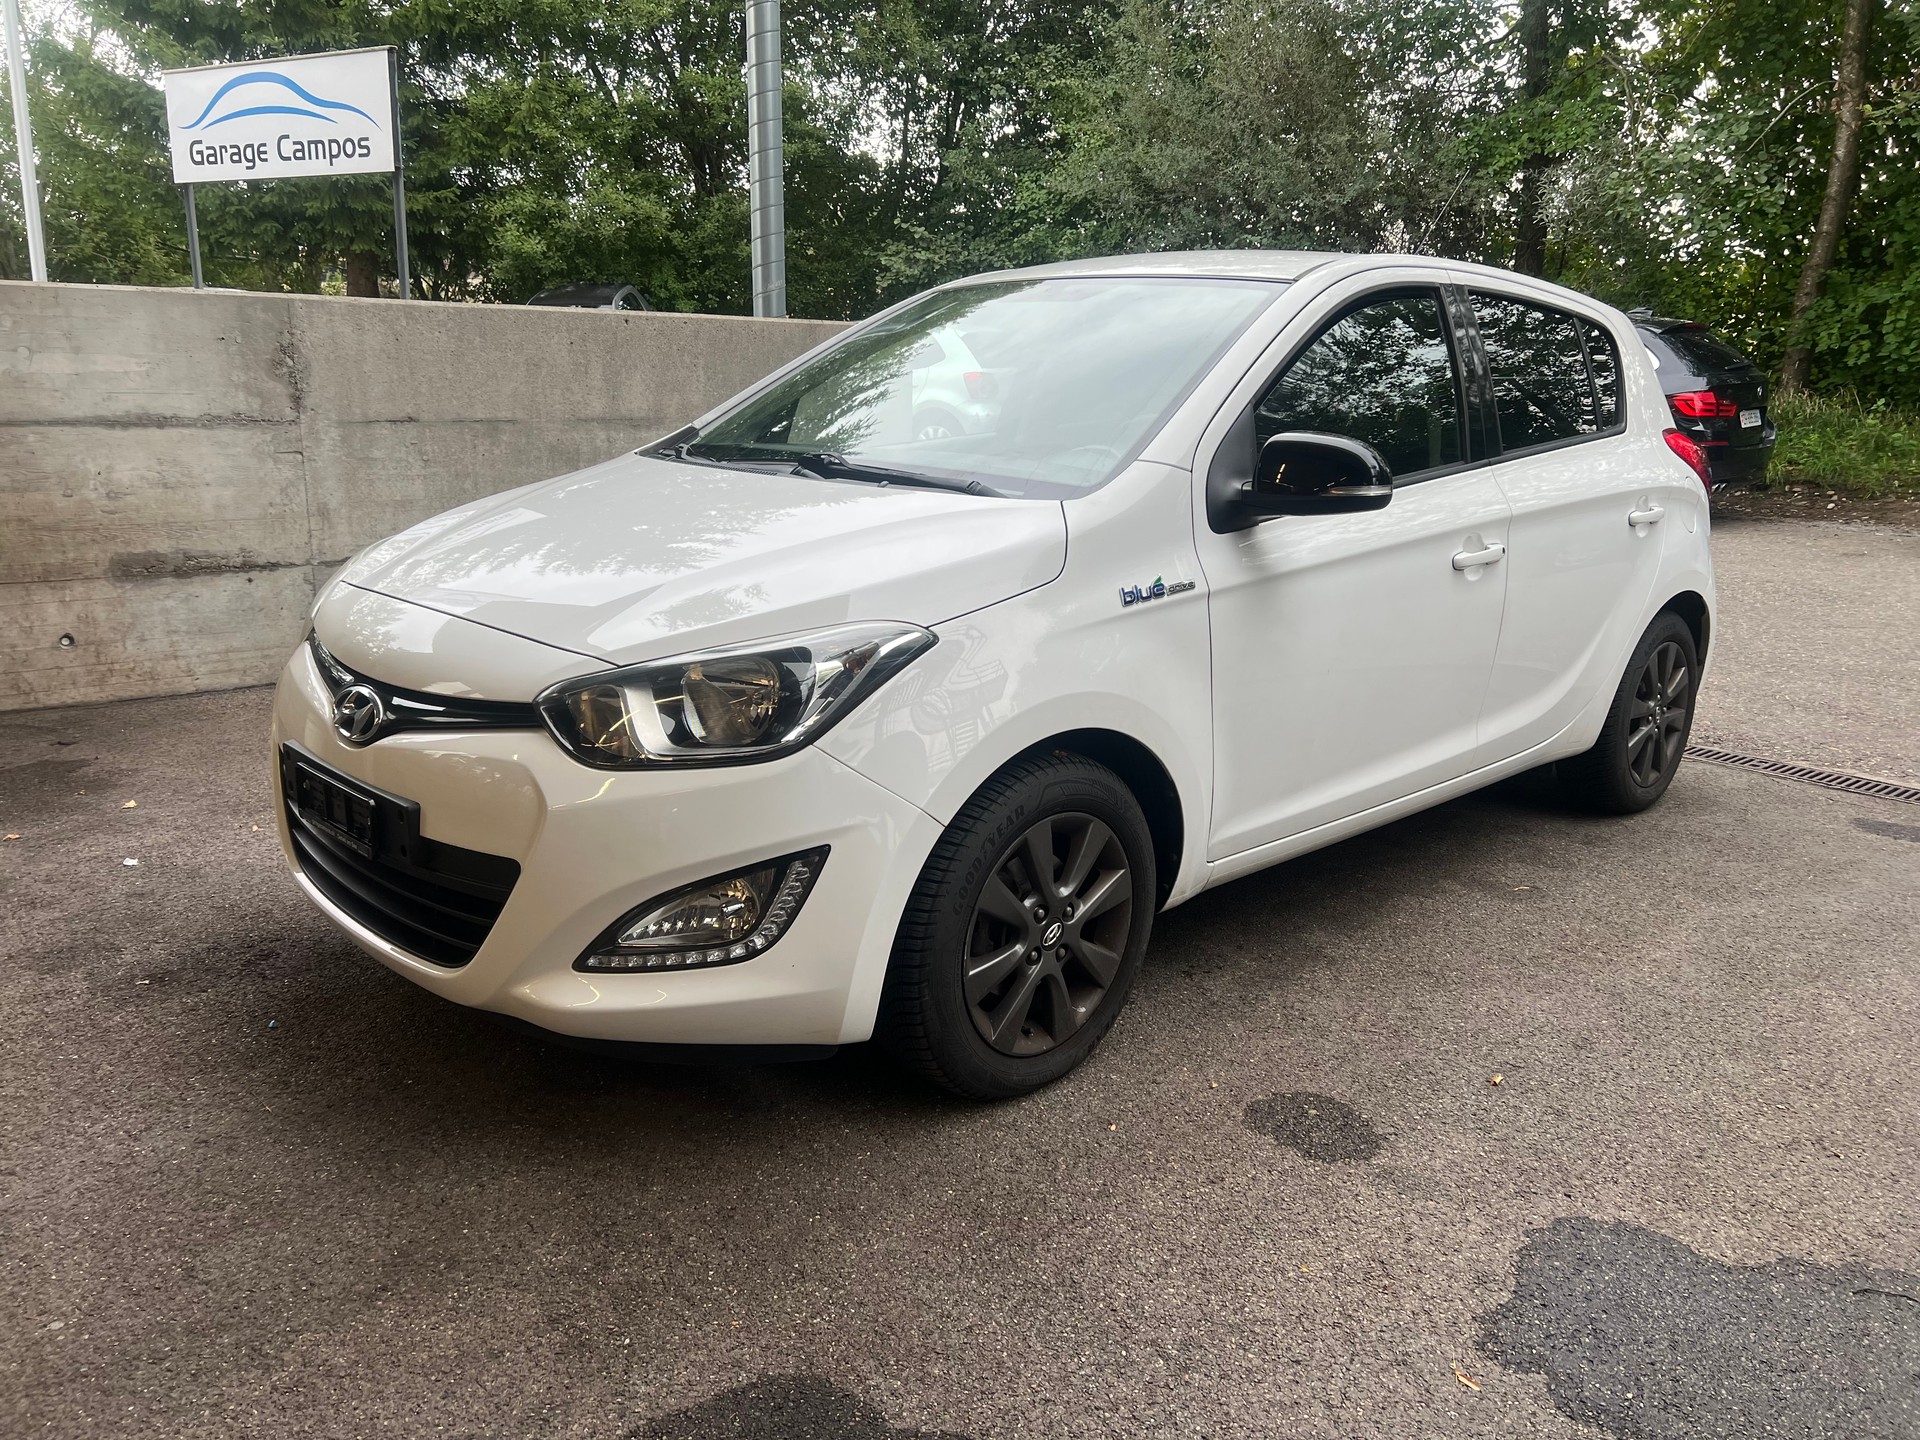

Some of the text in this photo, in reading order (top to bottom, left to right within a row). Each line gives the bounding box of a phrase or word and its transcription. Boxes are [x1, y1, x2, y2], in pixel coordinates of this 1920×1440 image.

[189, 134, 371, 170] Garage Campos
[1119, 577, 1166, 607] blue
